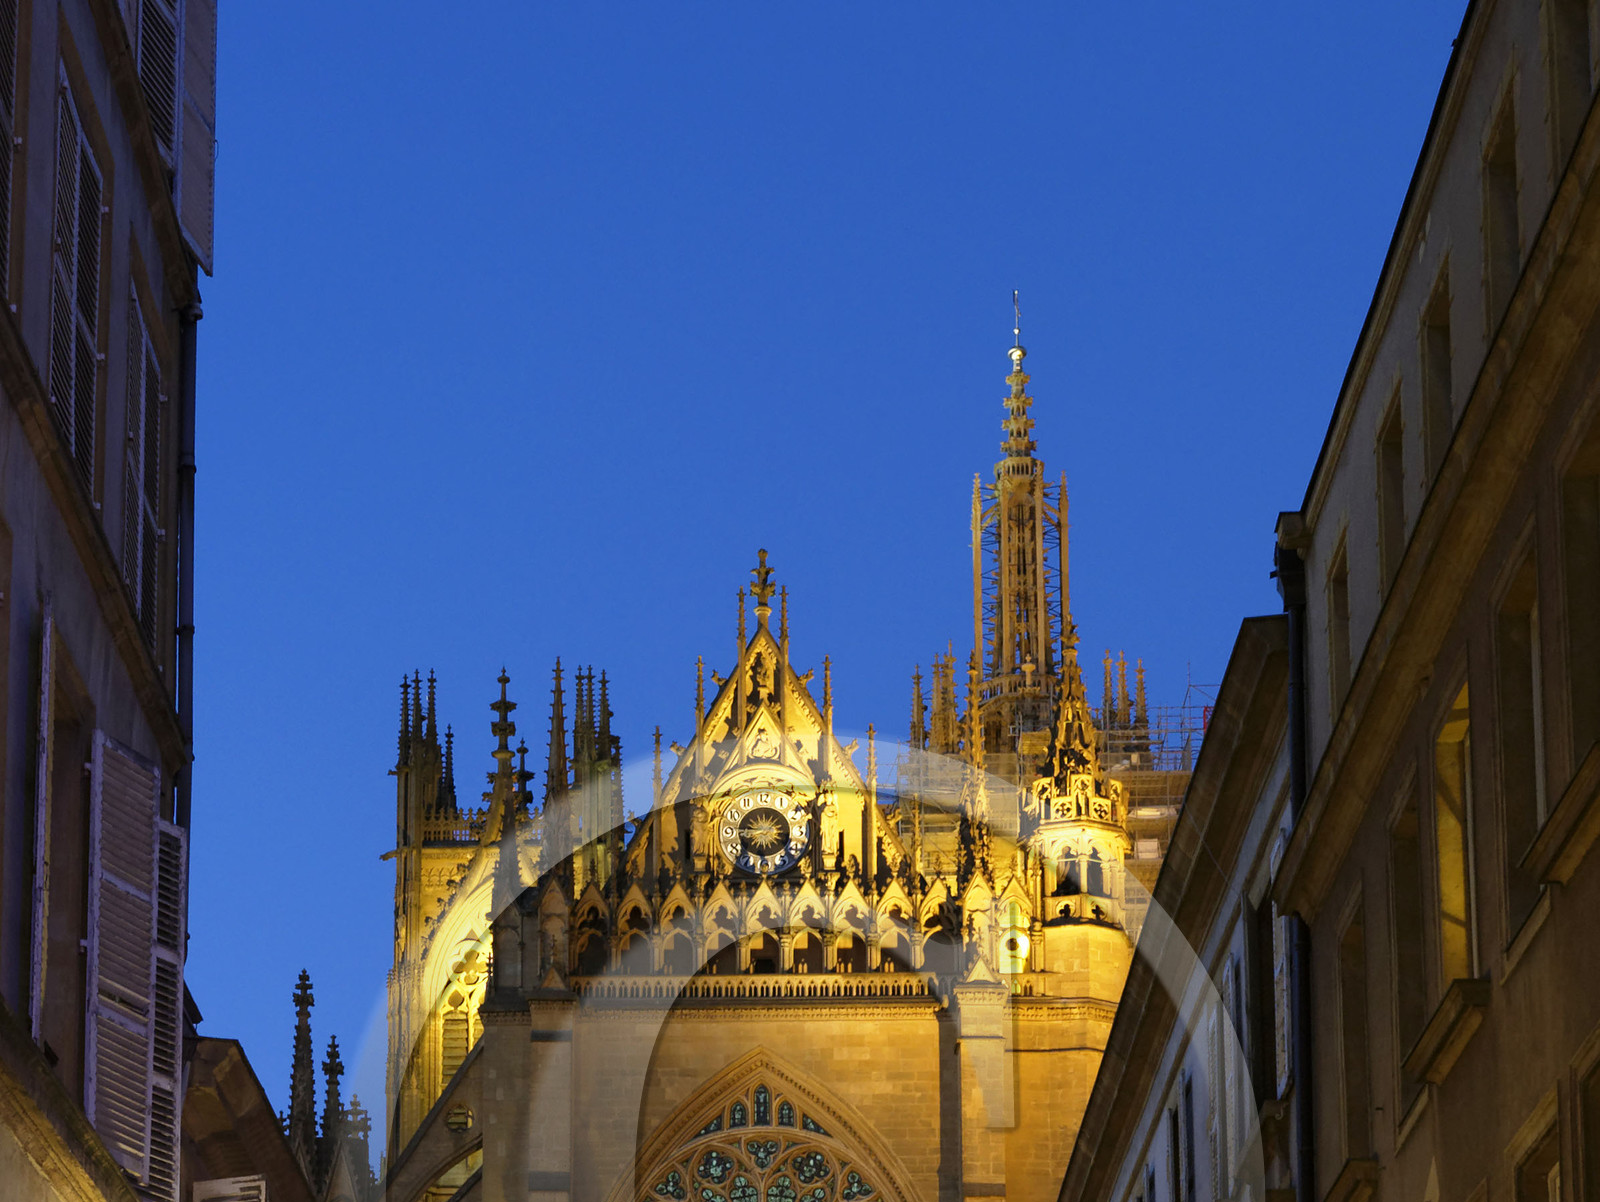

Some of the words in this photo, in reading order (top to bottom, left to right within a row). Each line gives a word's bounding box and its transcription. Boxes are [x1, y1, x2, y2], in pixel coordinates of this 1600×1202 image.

[743, 798, 750, 808] 11
[759, 794, 769, 803] 12
[730, 810, 740, 821] 10
[724, 828, 734, 837] 9
[796, 825, 803, 837] 3
[730, 844, 739, 854] 8
